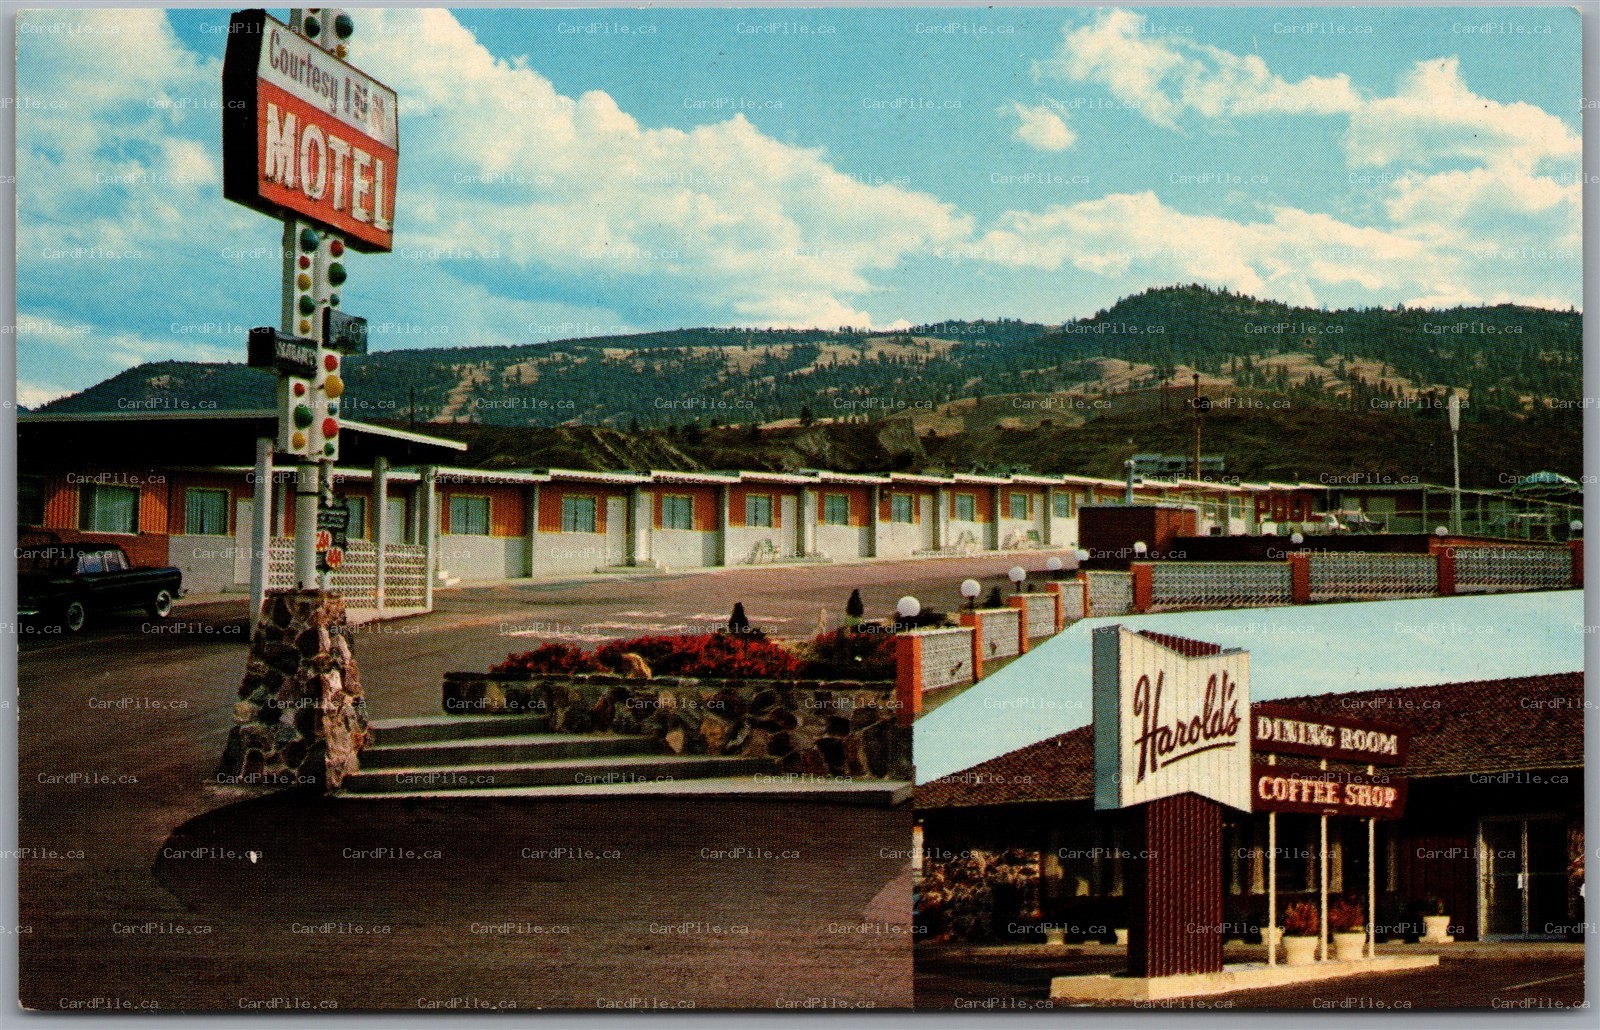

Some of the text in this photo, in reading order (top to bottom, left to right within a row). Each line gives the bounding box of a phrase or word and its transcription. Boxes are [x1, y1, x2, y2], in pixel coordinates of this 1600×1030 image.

[268, 28, 338, 114] Courtesy
[265, 101, 392, 234] MOTEL
[1254, 494, 1322, 524] POOL
[1133, 668, 1241, 785] Harold's
[1256, 714, 1398, 755] DINING ROOM
[1258, 776, 1398, 807] COFFEE SHOP
